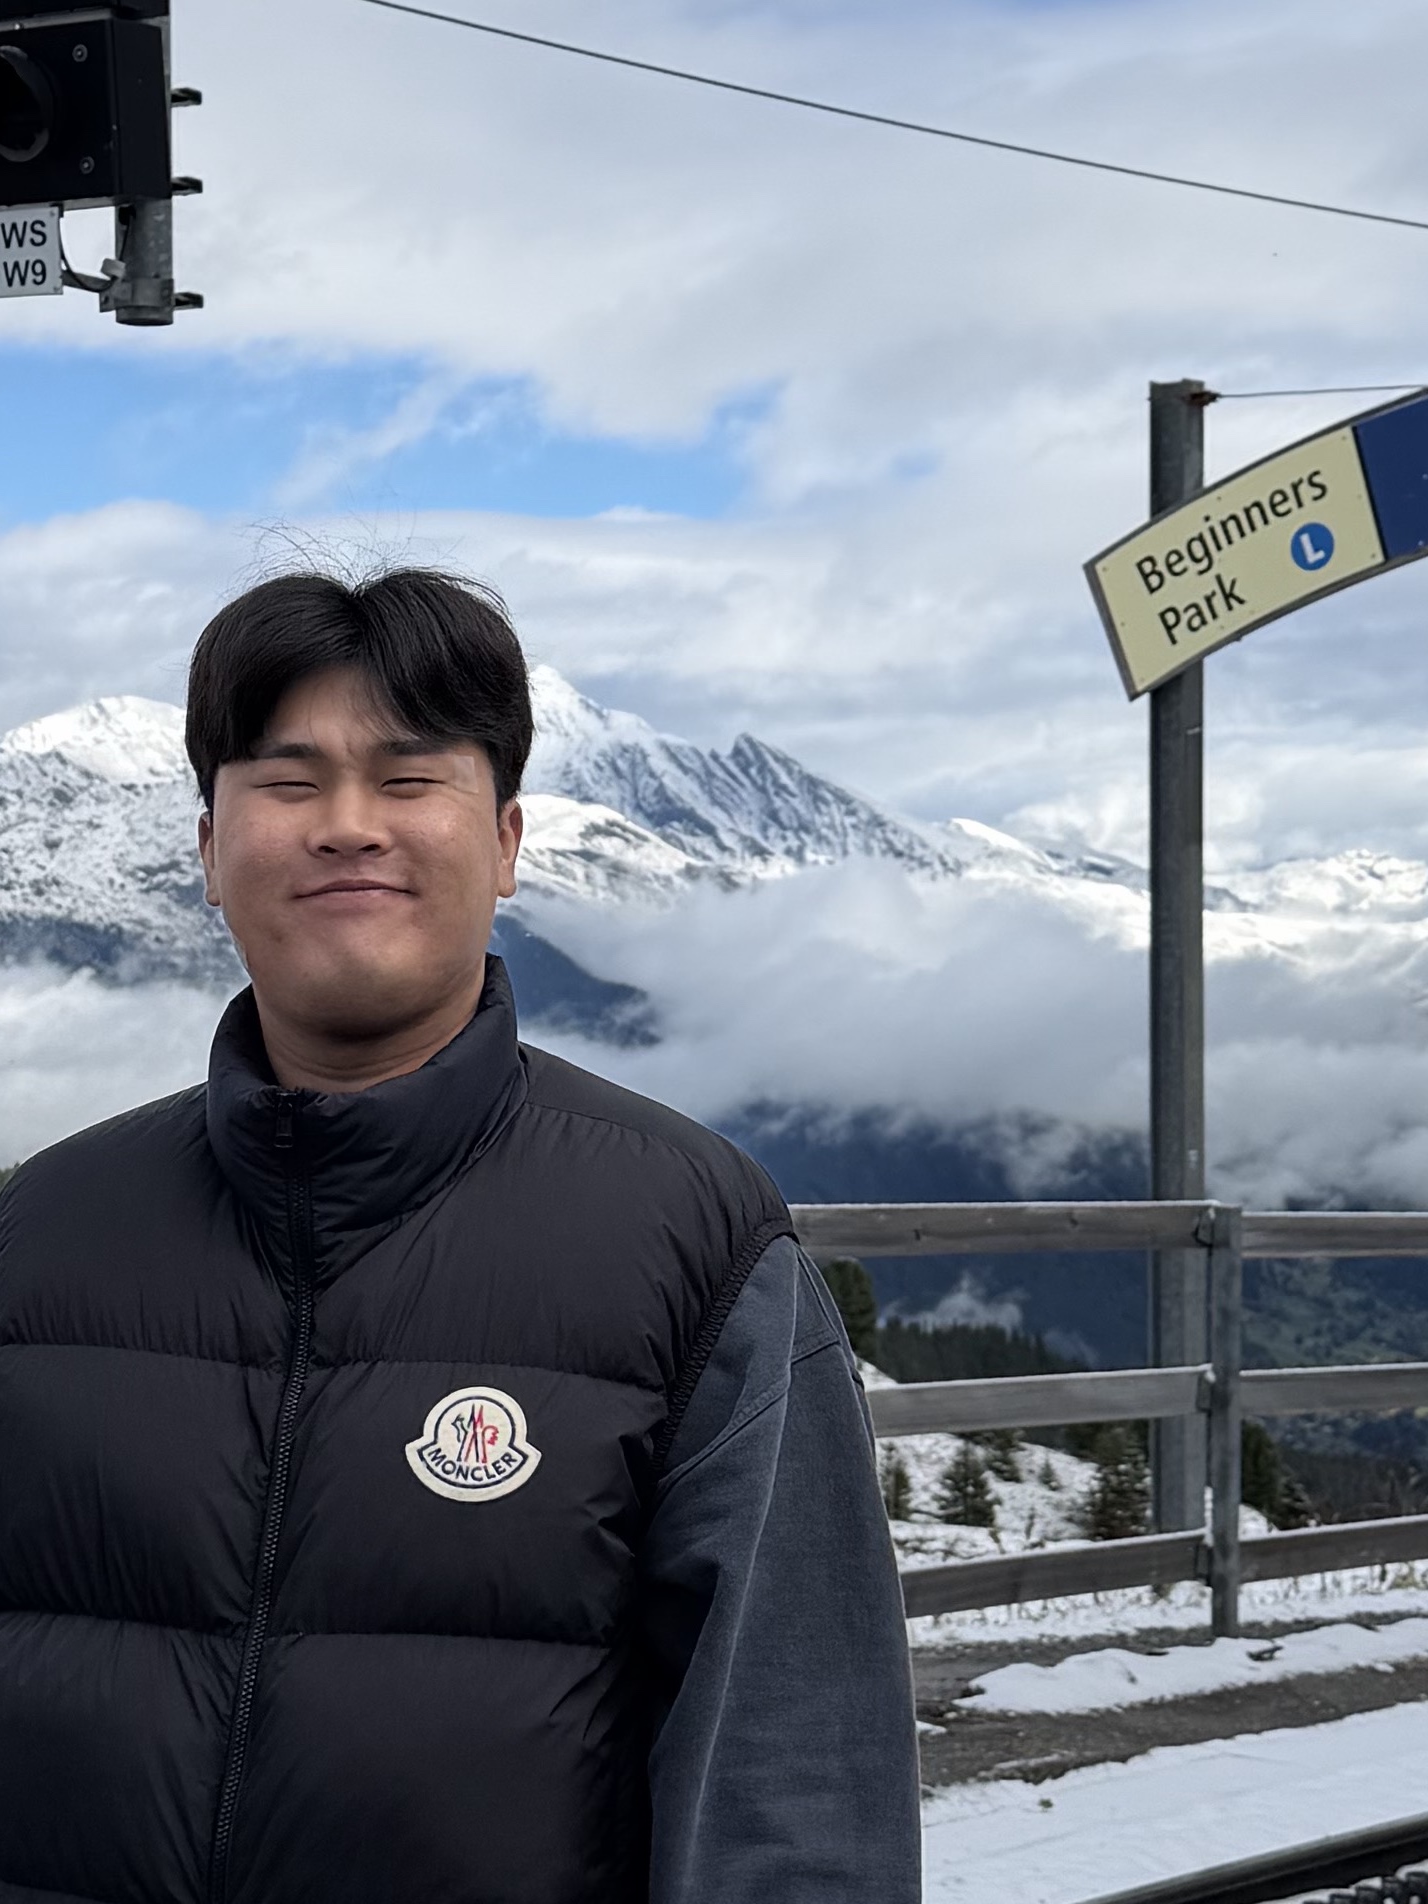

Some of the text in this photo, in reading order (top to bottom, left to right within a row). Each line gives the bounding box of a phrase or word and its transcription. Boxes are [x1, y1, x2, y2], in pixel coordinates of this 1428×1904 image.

[0, 219, 47, 249] WS
[3, 258, 47, 288] W9
[1135, 470, 1328, 595] Beginners
[1299, 532, 1326, 564] L
[1157, 573, 1246, 645] Park
[427, 1447, 518, 1482] MONCLER
